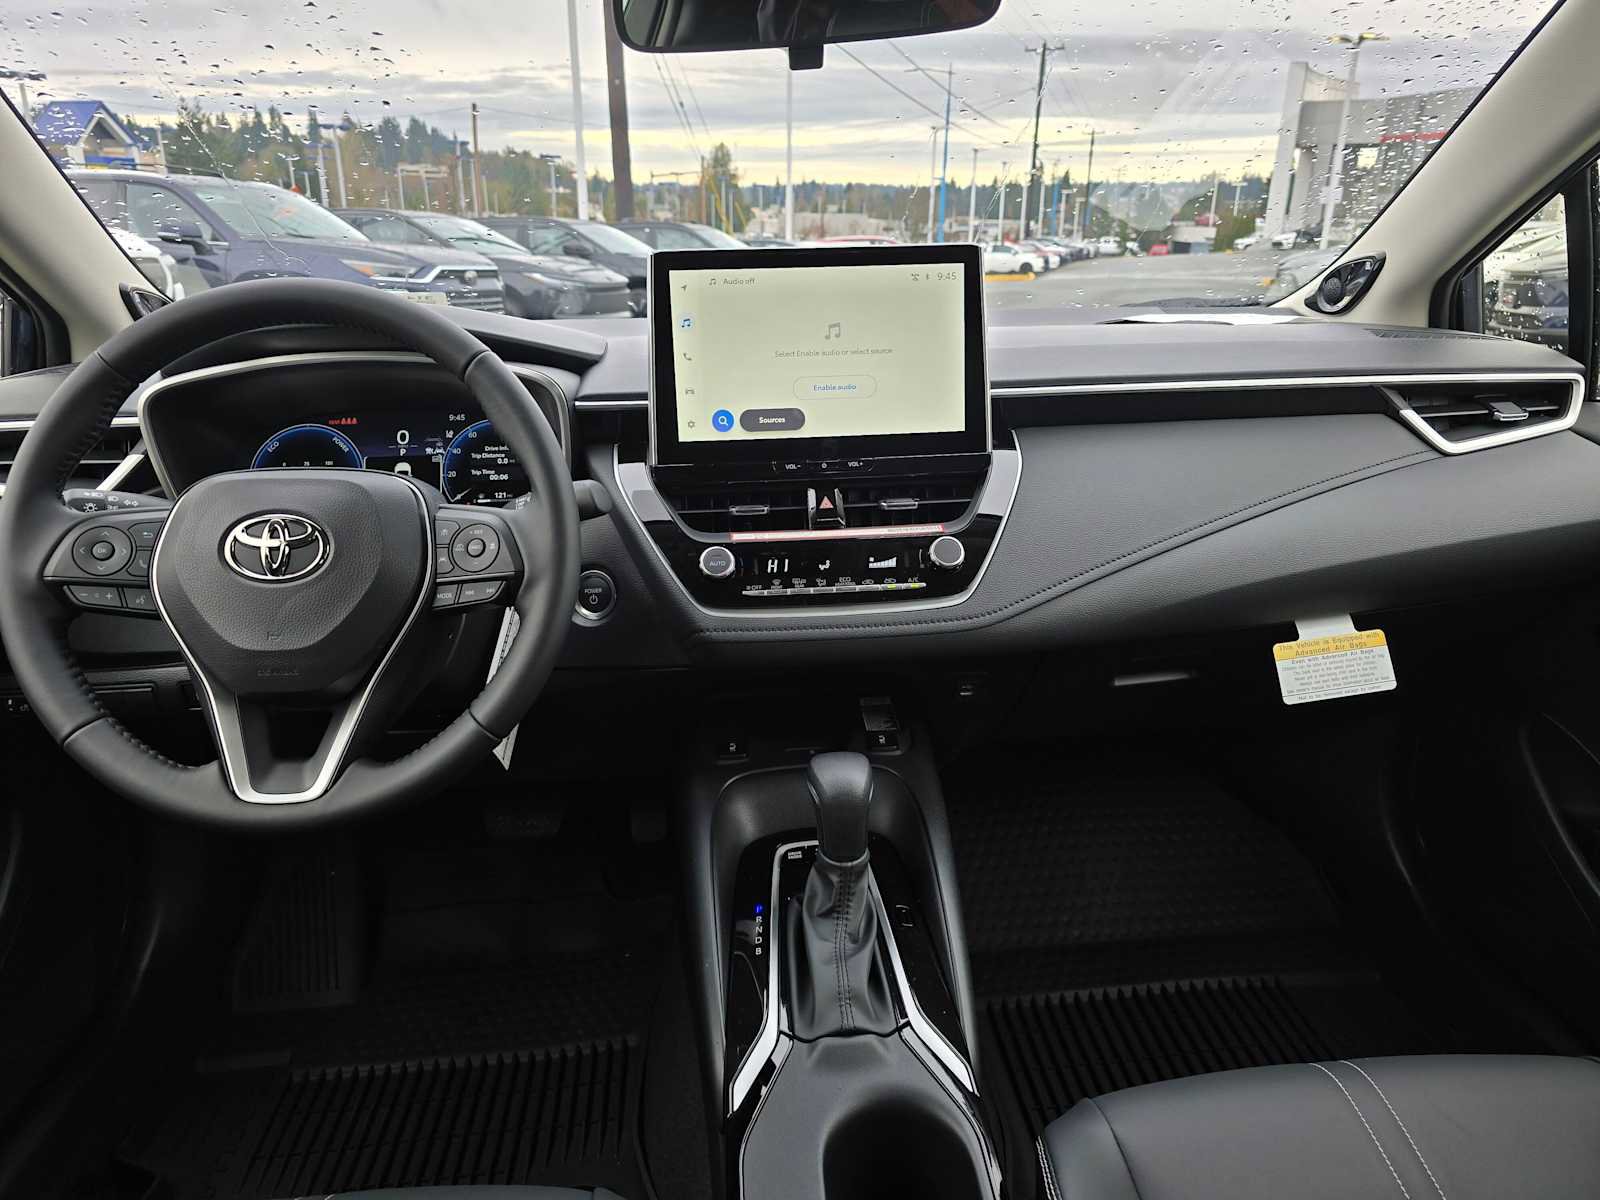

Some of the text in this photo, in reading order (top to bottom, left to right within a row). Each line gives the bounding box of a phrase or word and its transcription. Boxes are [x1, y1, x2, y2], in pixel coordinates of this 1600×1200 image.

[937, 272, 957, 281] 9:45
[723, 277, 755, 286] Audio off
[837, 383, 857, 391] audio
[759, 416, 786, 425] Sources
[397, 430, 409, 444] 0
[267, 441, 279, 453] ECO
[332, 434, 349, 453] POWER
[400, 448, 406, 456] P
[1295, 647, 1330, 656] Advanced
[755, 936, 762, 944] D
[755, 947, 762, 955] B
